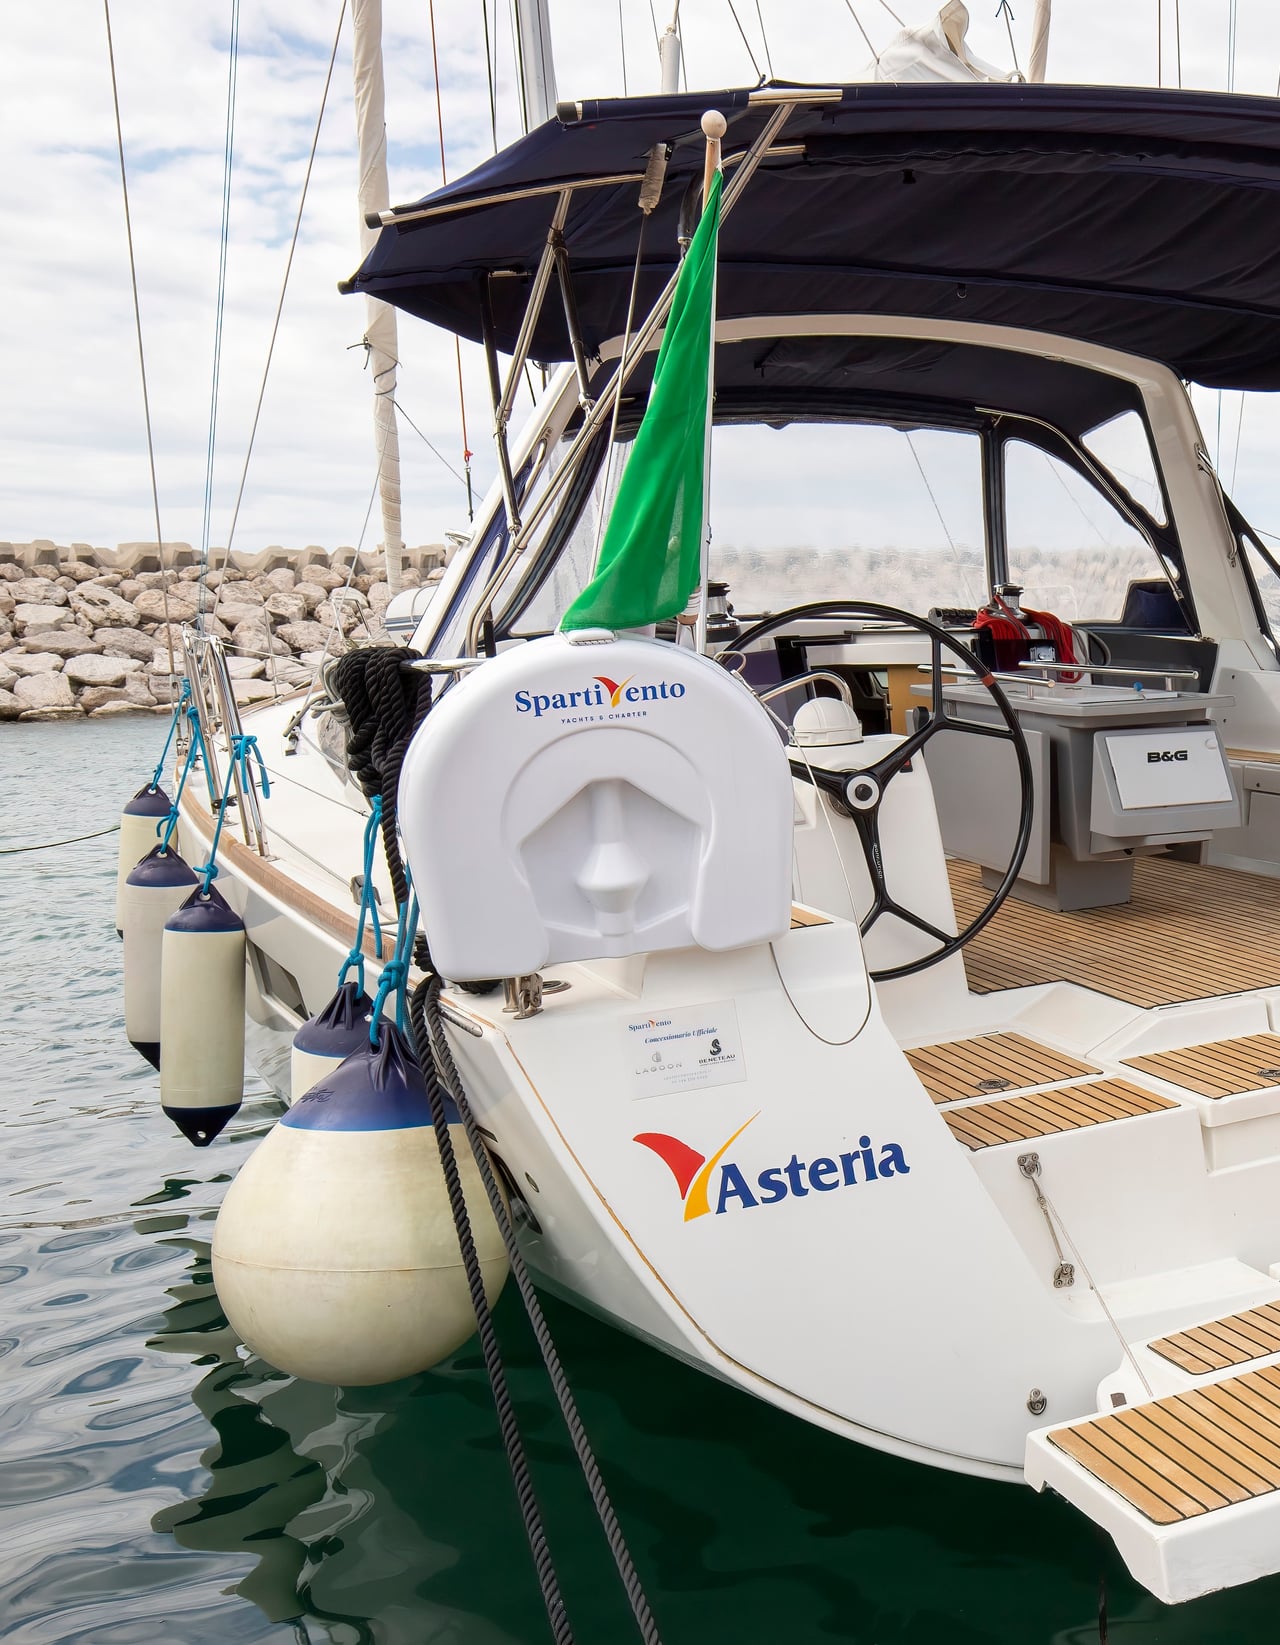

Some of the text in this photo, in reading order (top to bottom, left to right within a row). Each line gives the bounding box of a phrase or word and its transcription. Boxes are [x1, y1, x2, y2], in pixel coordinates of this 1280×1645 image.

[514, 673, 686, 717] SpartiVento
[561, 716, 595, 724] YACHTS
[608, 711, 647, 720] CHARTER
[1147, 750, 1188, 763] B&G
[698, 1053, 736, 1064] BENETEAU
[635, 1062, 683, 1075] LAGOON
[715, 1135, 911, 1215] Asteria
